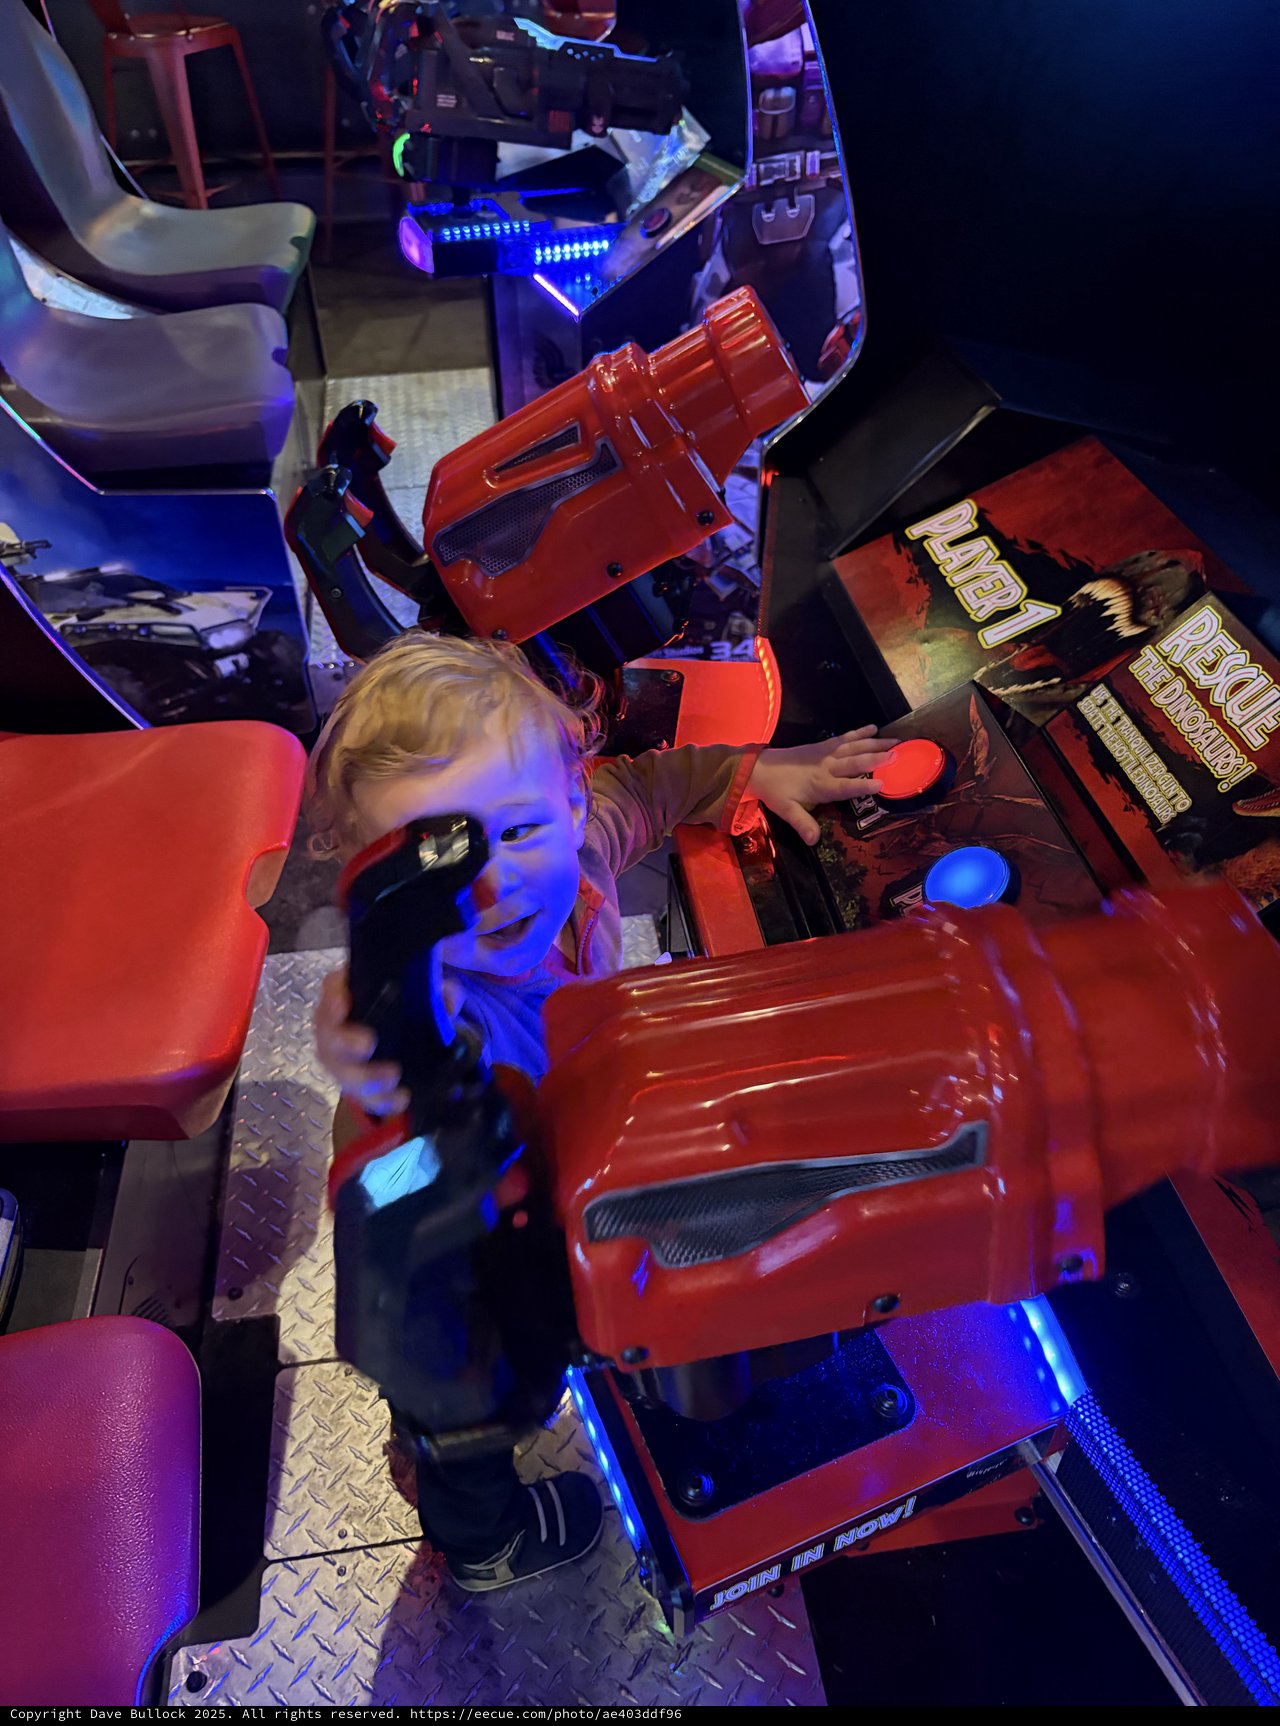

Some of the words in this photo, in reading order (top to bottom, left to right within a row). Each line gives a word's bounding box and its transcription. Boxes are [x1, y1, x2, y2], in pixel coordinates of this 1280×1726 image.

[905, 499, 1028, 623] PLAYER
[978, 599, 1062, 650] 1
[1090, 683, 1112, 706] USE
[1128, 644, 1176, 695] THE
[1155, 605, 1280, 751] RESCUE
[1100, 696, 1125, 726] THE
[1150, 675, 1258, 794] DINOSAURS!
[1077, 695, 1107, 732] SEDATE
[1097, 722, 1119, 751] THE
[1111, 740, 1141, 781] HOSTILE
[1135, 764, 1178, 824] DINOSAURS
[1113, 713, 1168, 781] TRANQUILIZER
[1156, 772, 1181, 800] GUN
[1170, 788, 1193, 813] TO
[710, 1563, 782, 1610] JOIN
[791, 1542, 825, 1572] IN
[833, 1496, 917, 1552] NOW!
